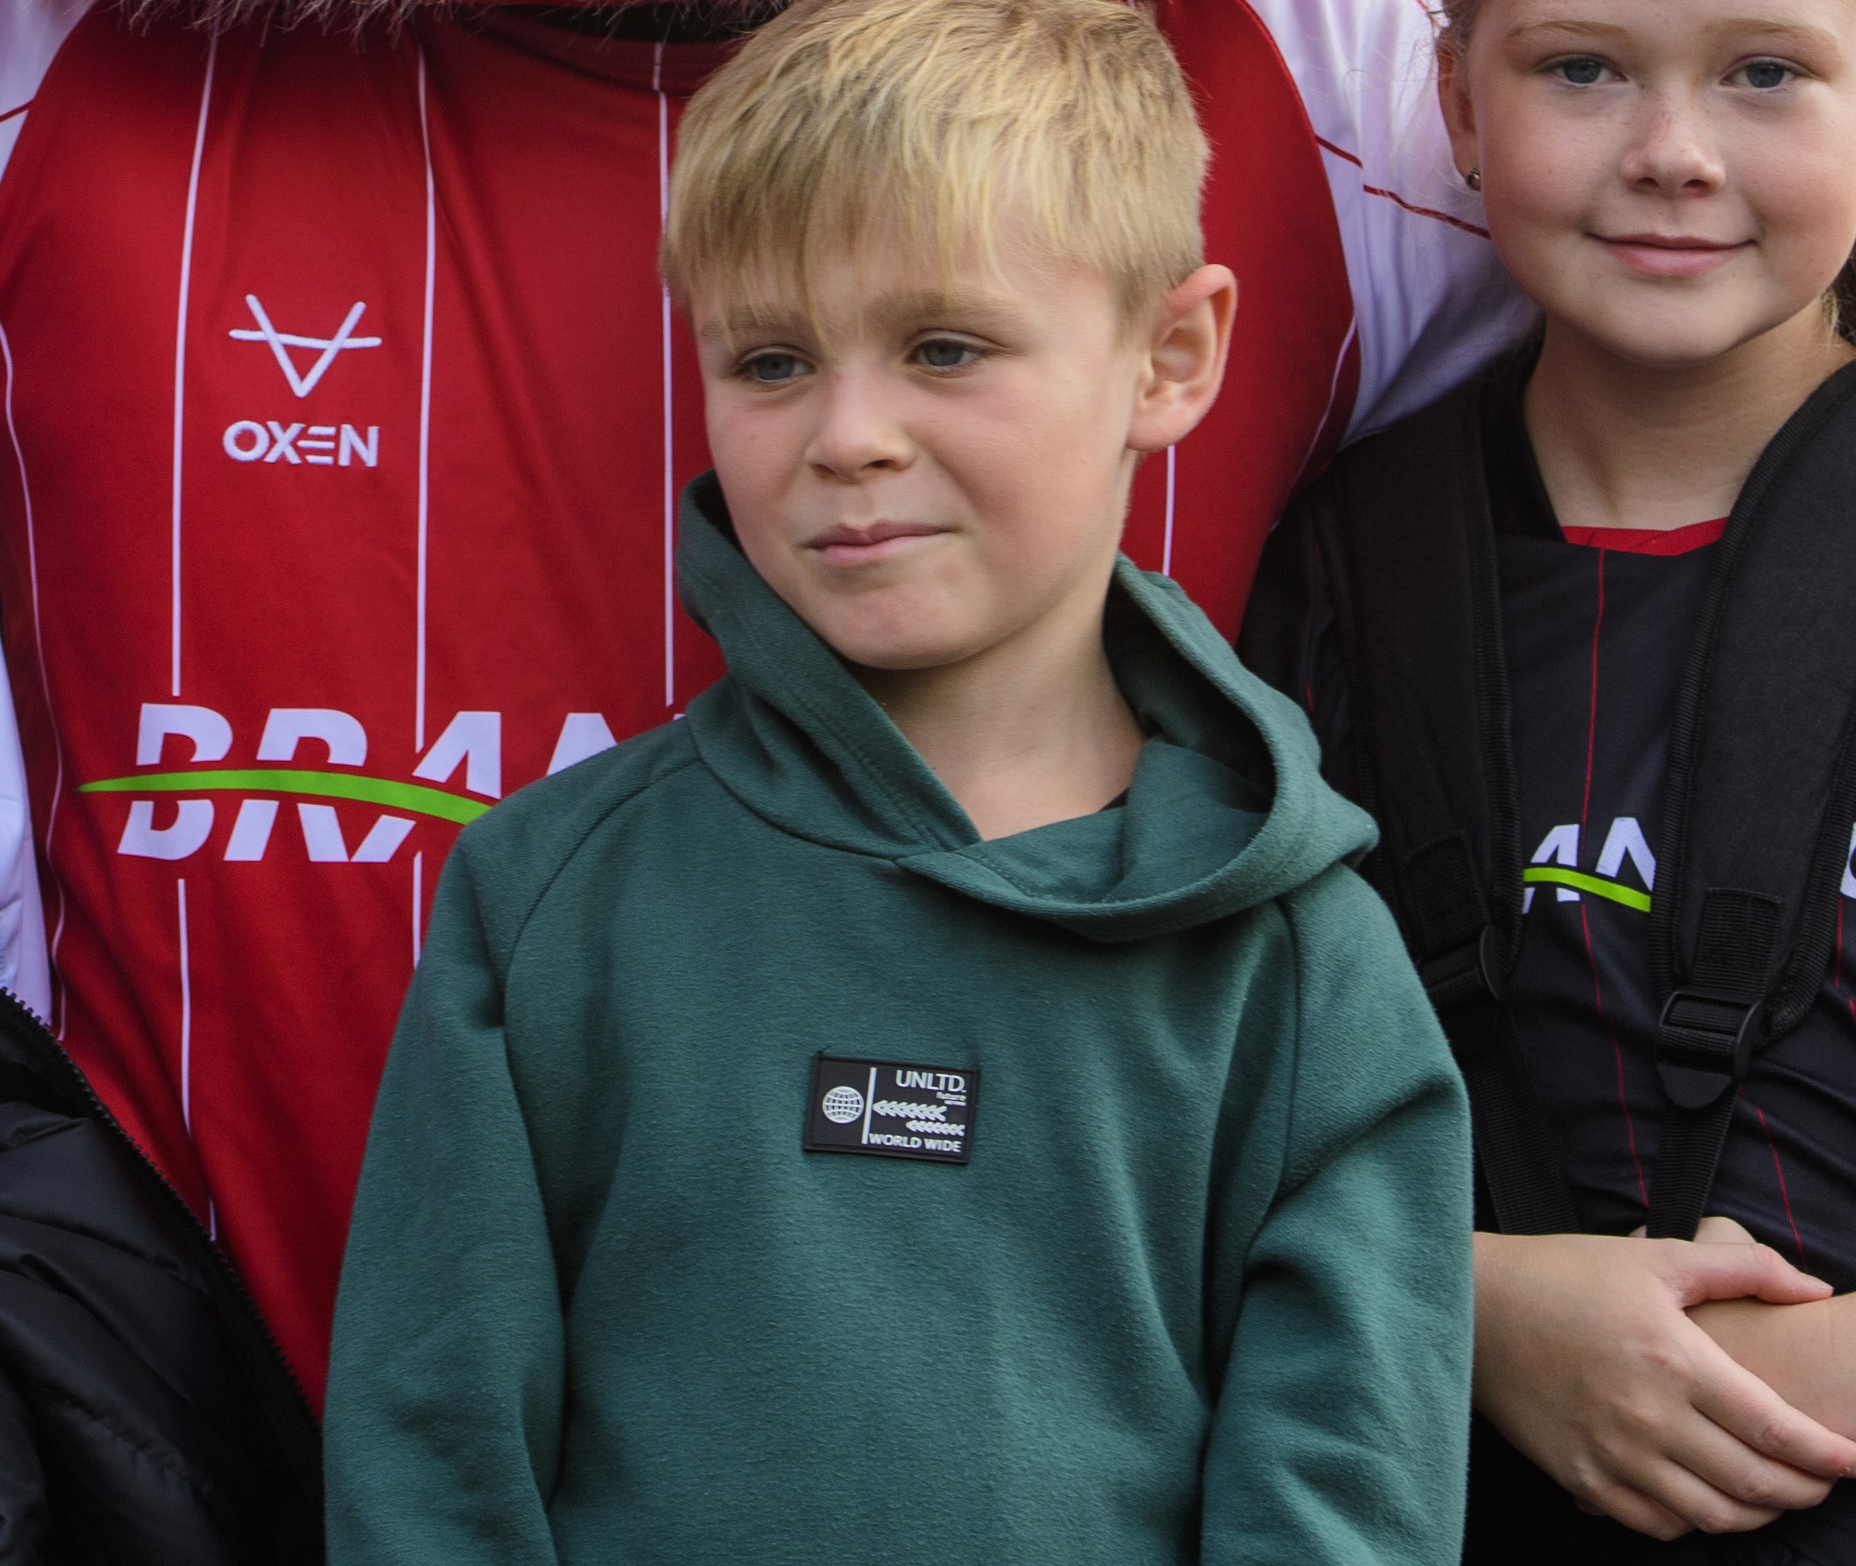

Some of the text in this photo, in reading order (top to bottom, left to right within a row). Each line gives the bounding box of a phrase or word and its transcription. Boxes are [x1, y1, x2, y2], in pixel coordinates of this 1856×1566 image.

[223, 420, 379, 468] OXEN
[869, 1132, 963, 1153] WORLD WIDE
